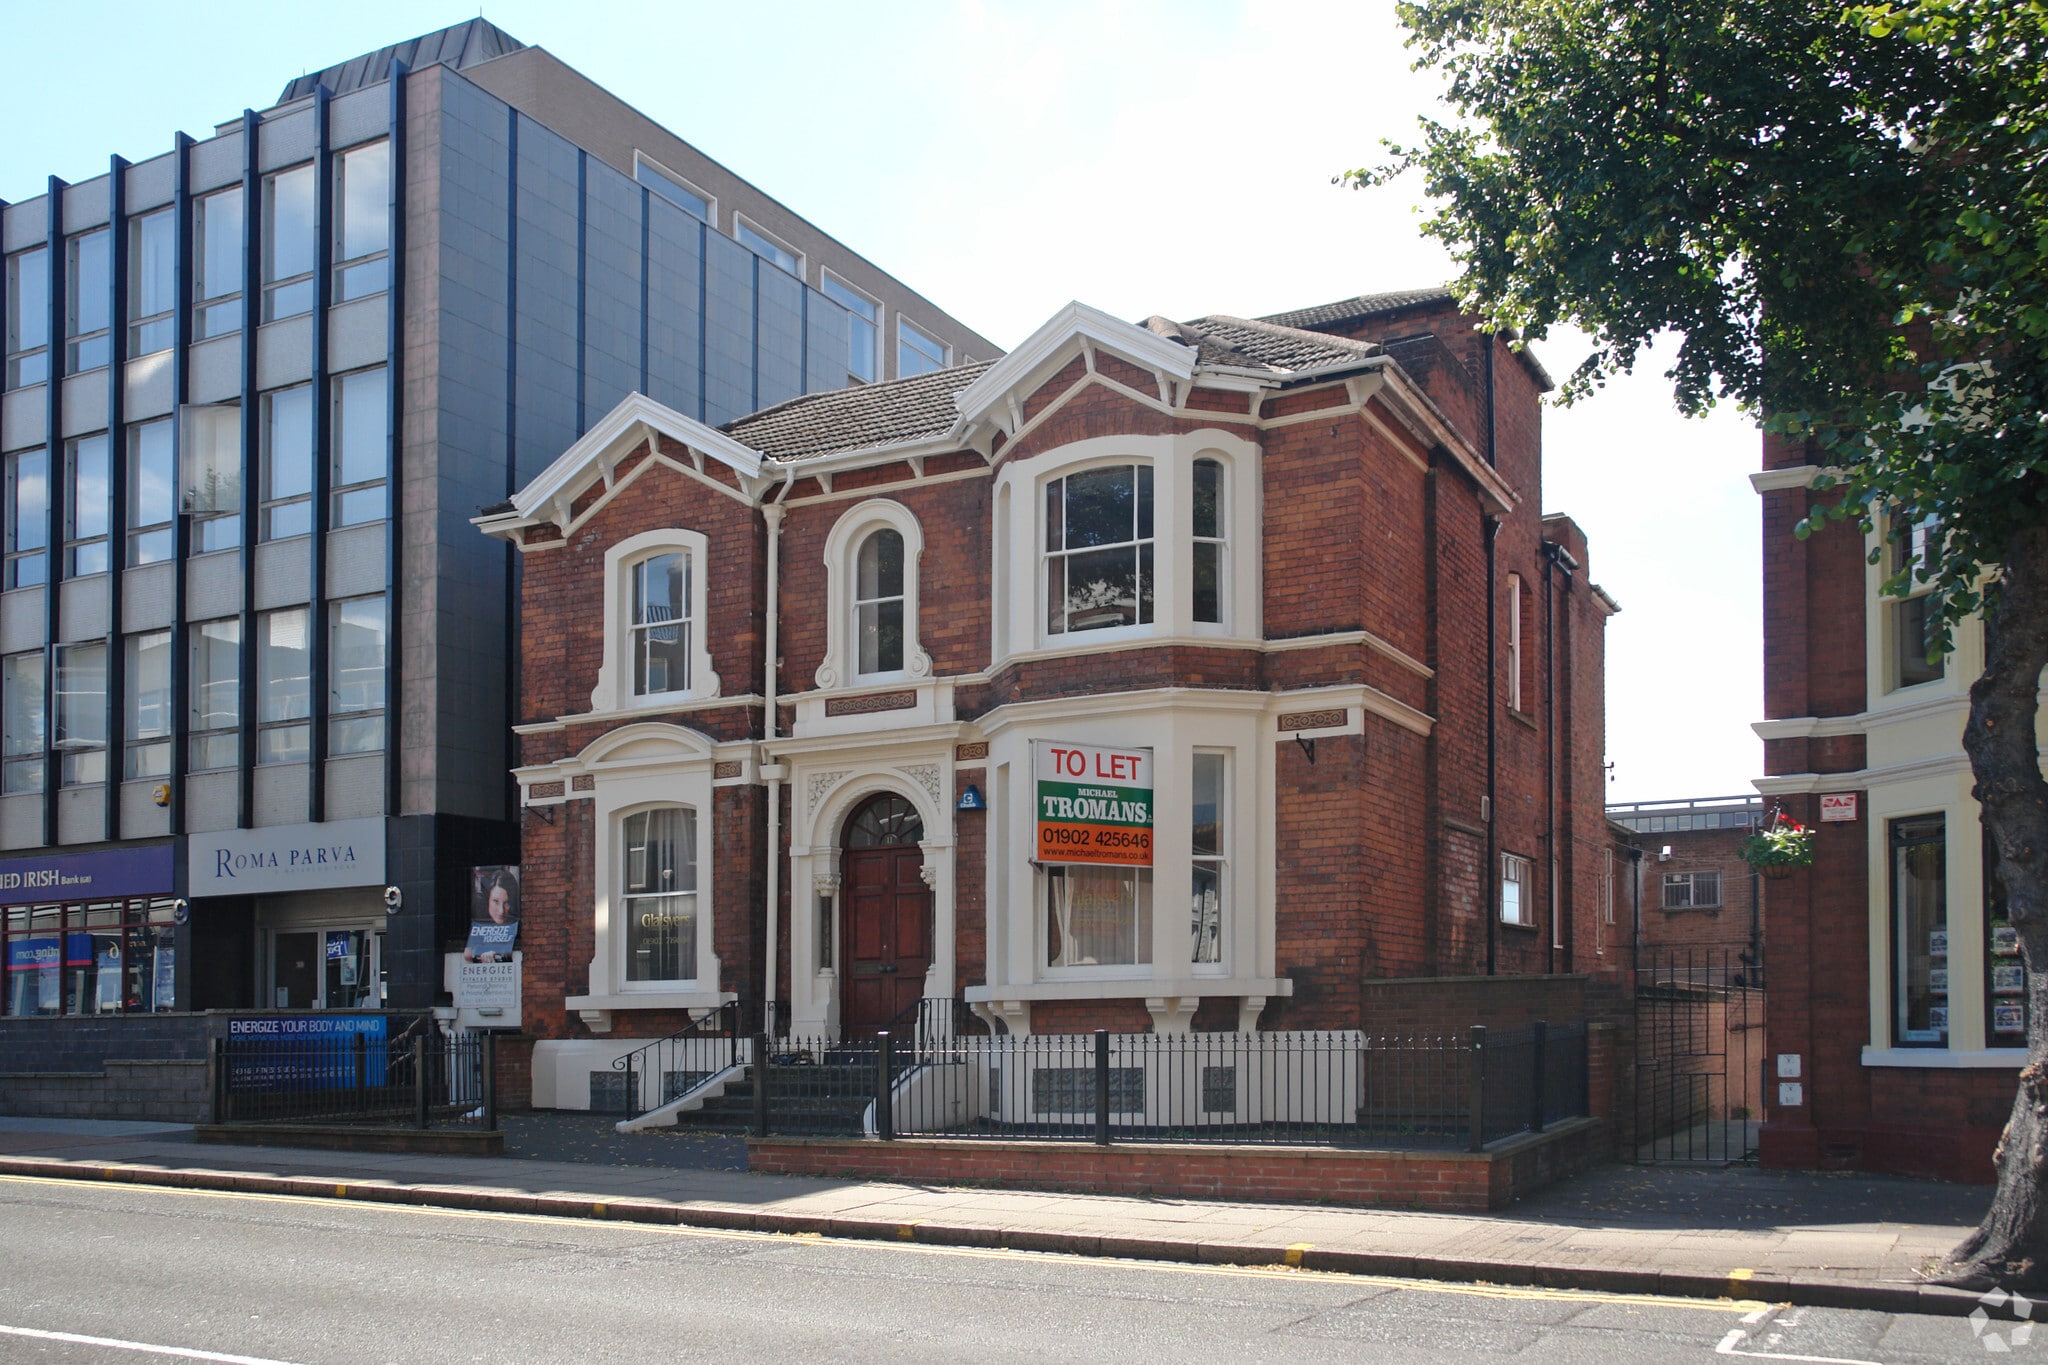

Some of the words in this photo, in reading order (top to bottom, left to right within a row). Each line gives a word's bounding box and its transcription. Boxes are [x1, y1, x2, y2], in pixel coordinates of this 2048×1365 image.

[1050, 748, 1086, 777] TO
[1095, 752, 1142, 781] LET
[1078, 788, 1118, 799] MICHAEL
[1042, 795, 1147, 824] TROMANS
[1043, 828, 1090, 846] 01902
[1095, 831, 1150, 849] 425646
[290, 845, 356, 866] PARVA
[1043, 848, 1149, 860] www.michaeltromans.co.uk
[23, 869, 59, 888] IRISH
[61, 875, 79, 885] Bank
[471, 926, 510, 936] ENERGIZE
[463, 966, 513, 975] ENERGIZE
[230, 1020, 279, 1034] ENERGIZE
[280, 1020, 308, 1033] YOUR
[309, 1020, 334, 1033] BODY
[334, 1020, 355, 1032] AND
[355, 1019, 380, 1032] MIND
